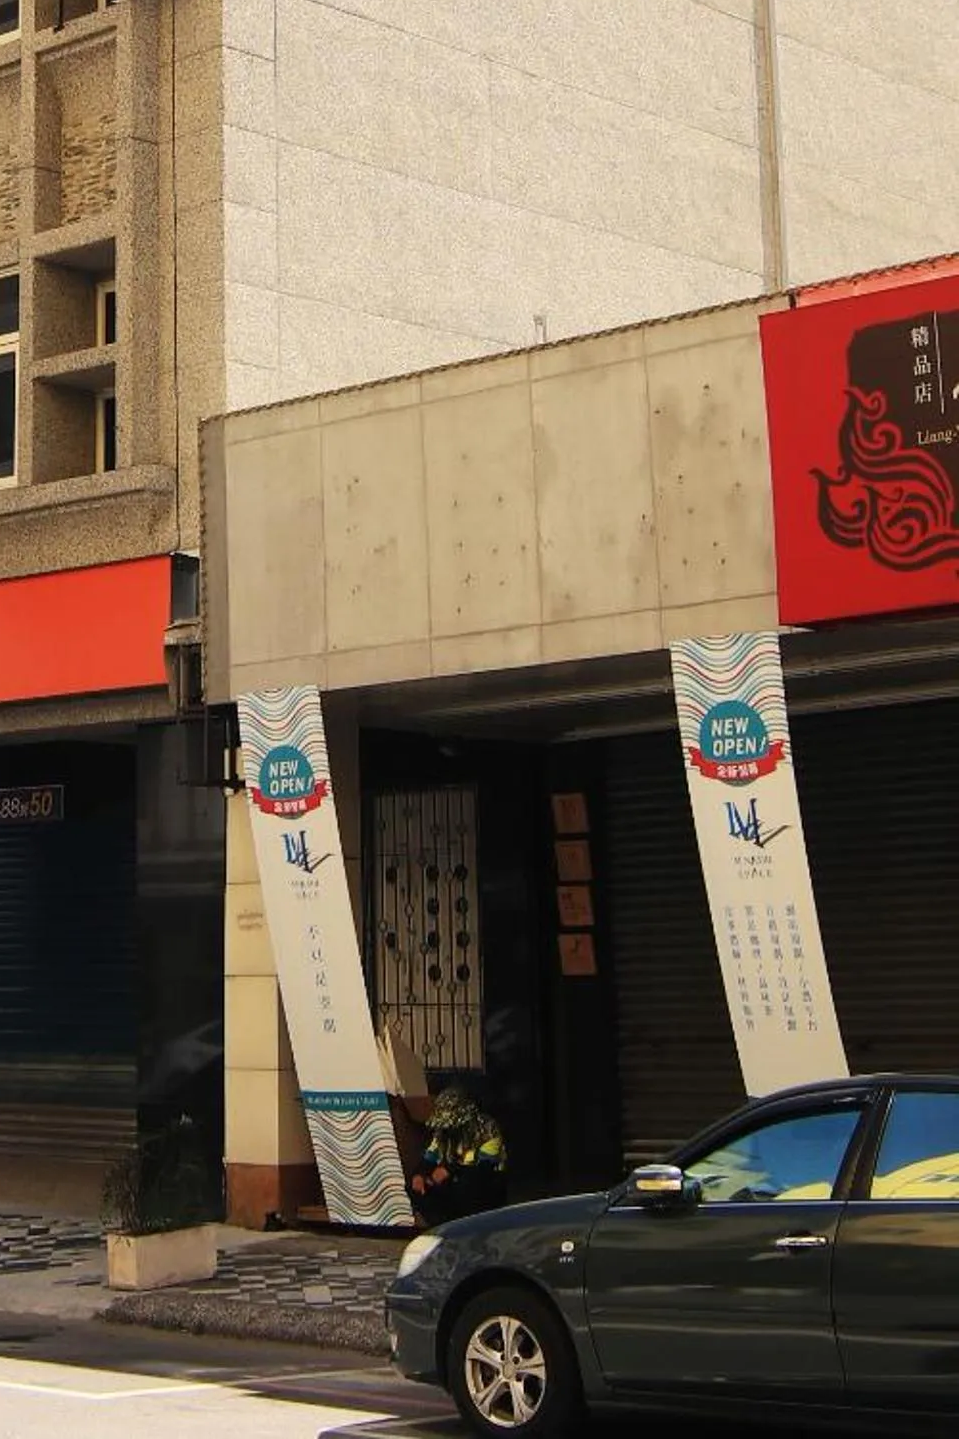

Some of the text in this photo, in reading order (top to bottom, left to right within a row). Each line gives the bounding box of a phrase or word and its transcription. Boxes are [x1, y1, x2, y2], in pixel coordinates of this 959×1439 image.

[910, 326, 933, 405] 精品店
[711, 717, 749, 736] NEW
[269, 759, 298, 778] NEW
